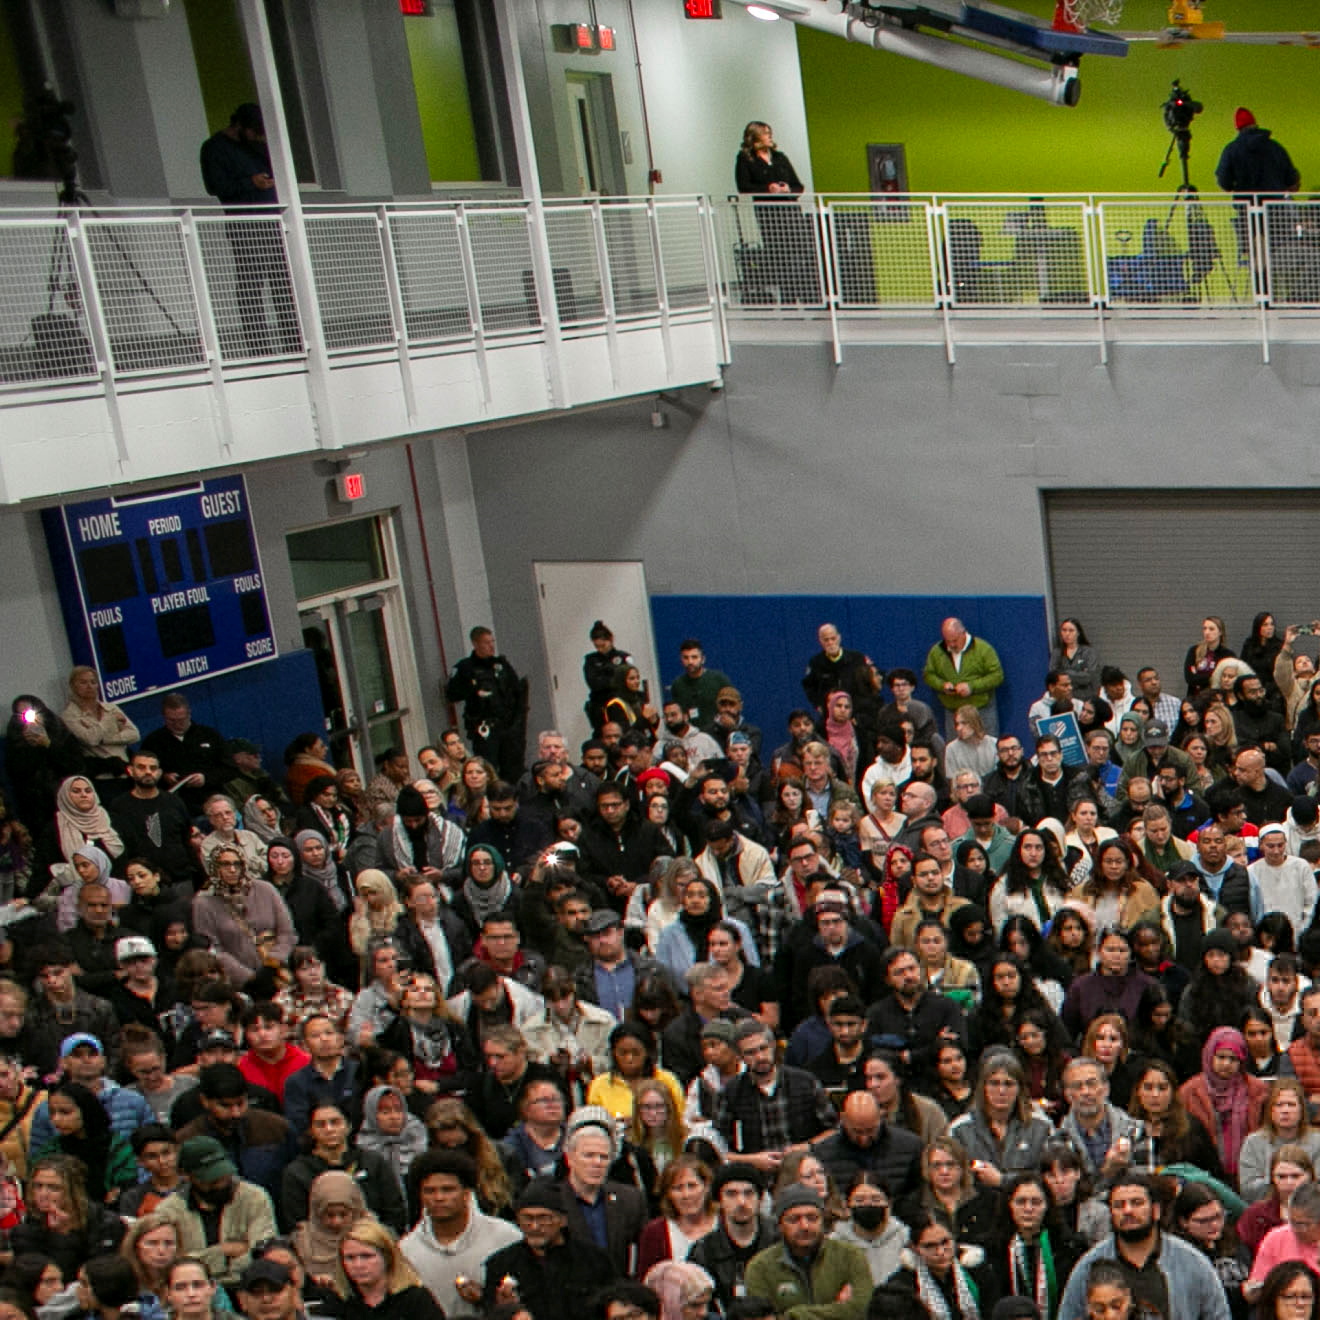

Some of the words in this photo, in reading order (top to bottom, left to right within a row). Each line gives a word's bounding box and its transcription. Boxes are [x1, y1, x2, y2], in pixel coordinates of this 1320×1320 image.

[201, 490, 242, 518] GUEST
[78, 512, 122, 542] HOME
[148, 515, 182, 536] PERIOD
[234, 573, 262, 594] FOULS
[151, 591, 187, 614] PLAYER
[187, 586, 211, 605] FOUL
[91, 606, 123, 628] FOULS
[245, 637, 273, 658] SCORE
[176, 655, 209, 678] MATCH
[105, 675, 138, 698] SCORE
